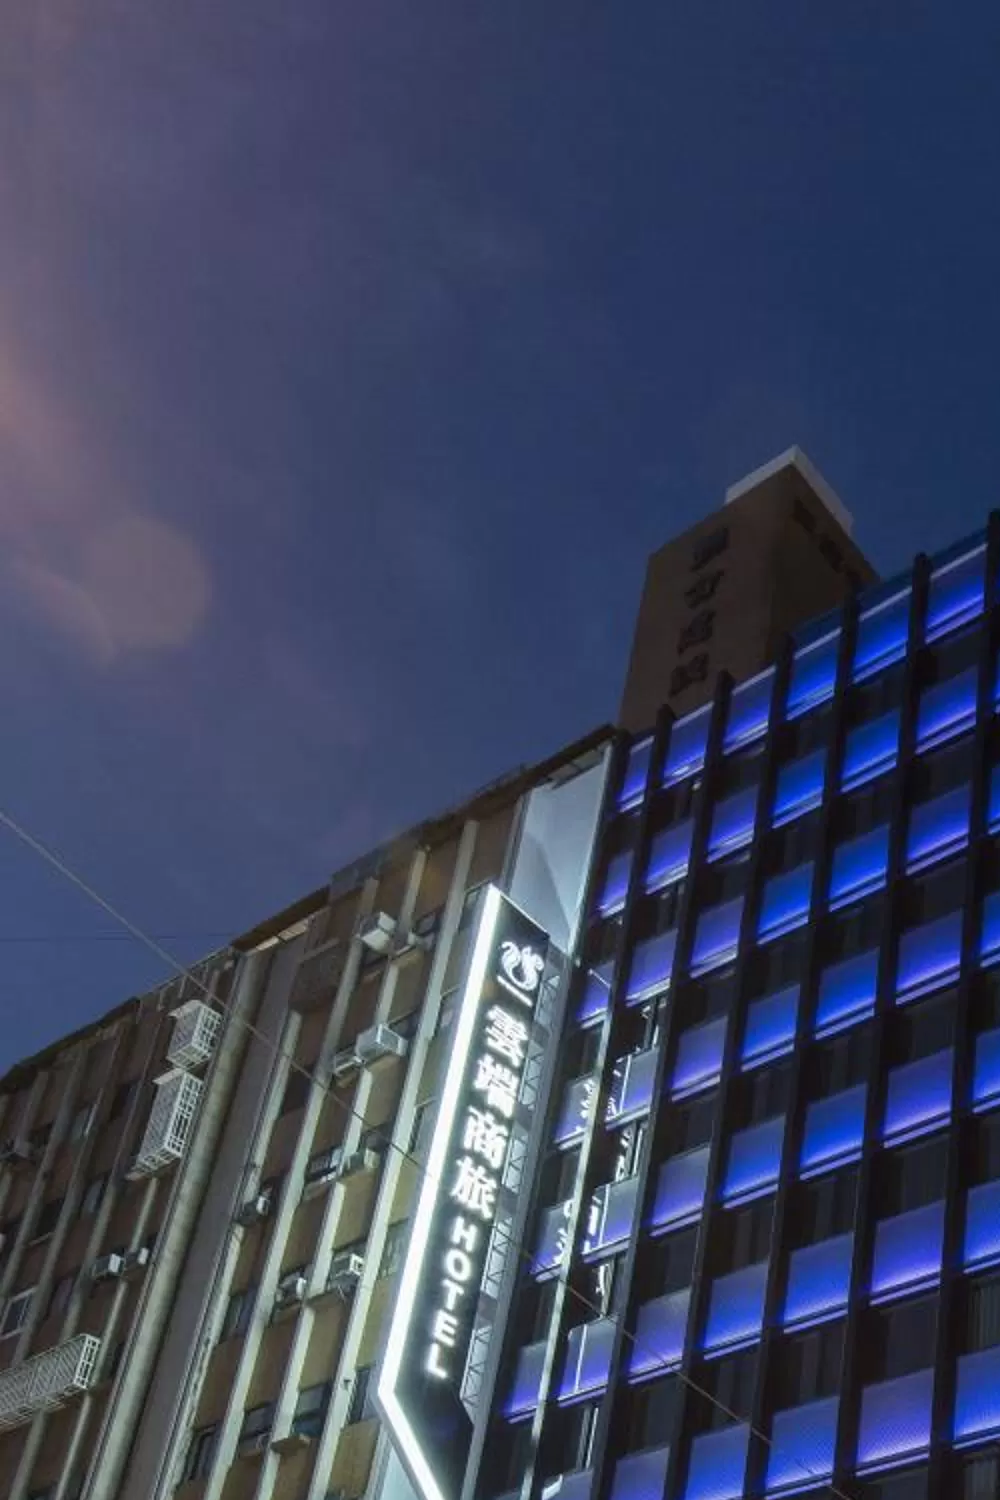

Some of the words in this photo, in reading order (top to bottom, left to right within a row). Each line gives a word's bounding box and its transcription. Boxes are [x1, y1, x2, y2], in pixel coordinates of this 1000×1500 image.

[449, 1004, 527, 1220] 雲端商旅
[426, 1216, 479, 1380] HOTEL
